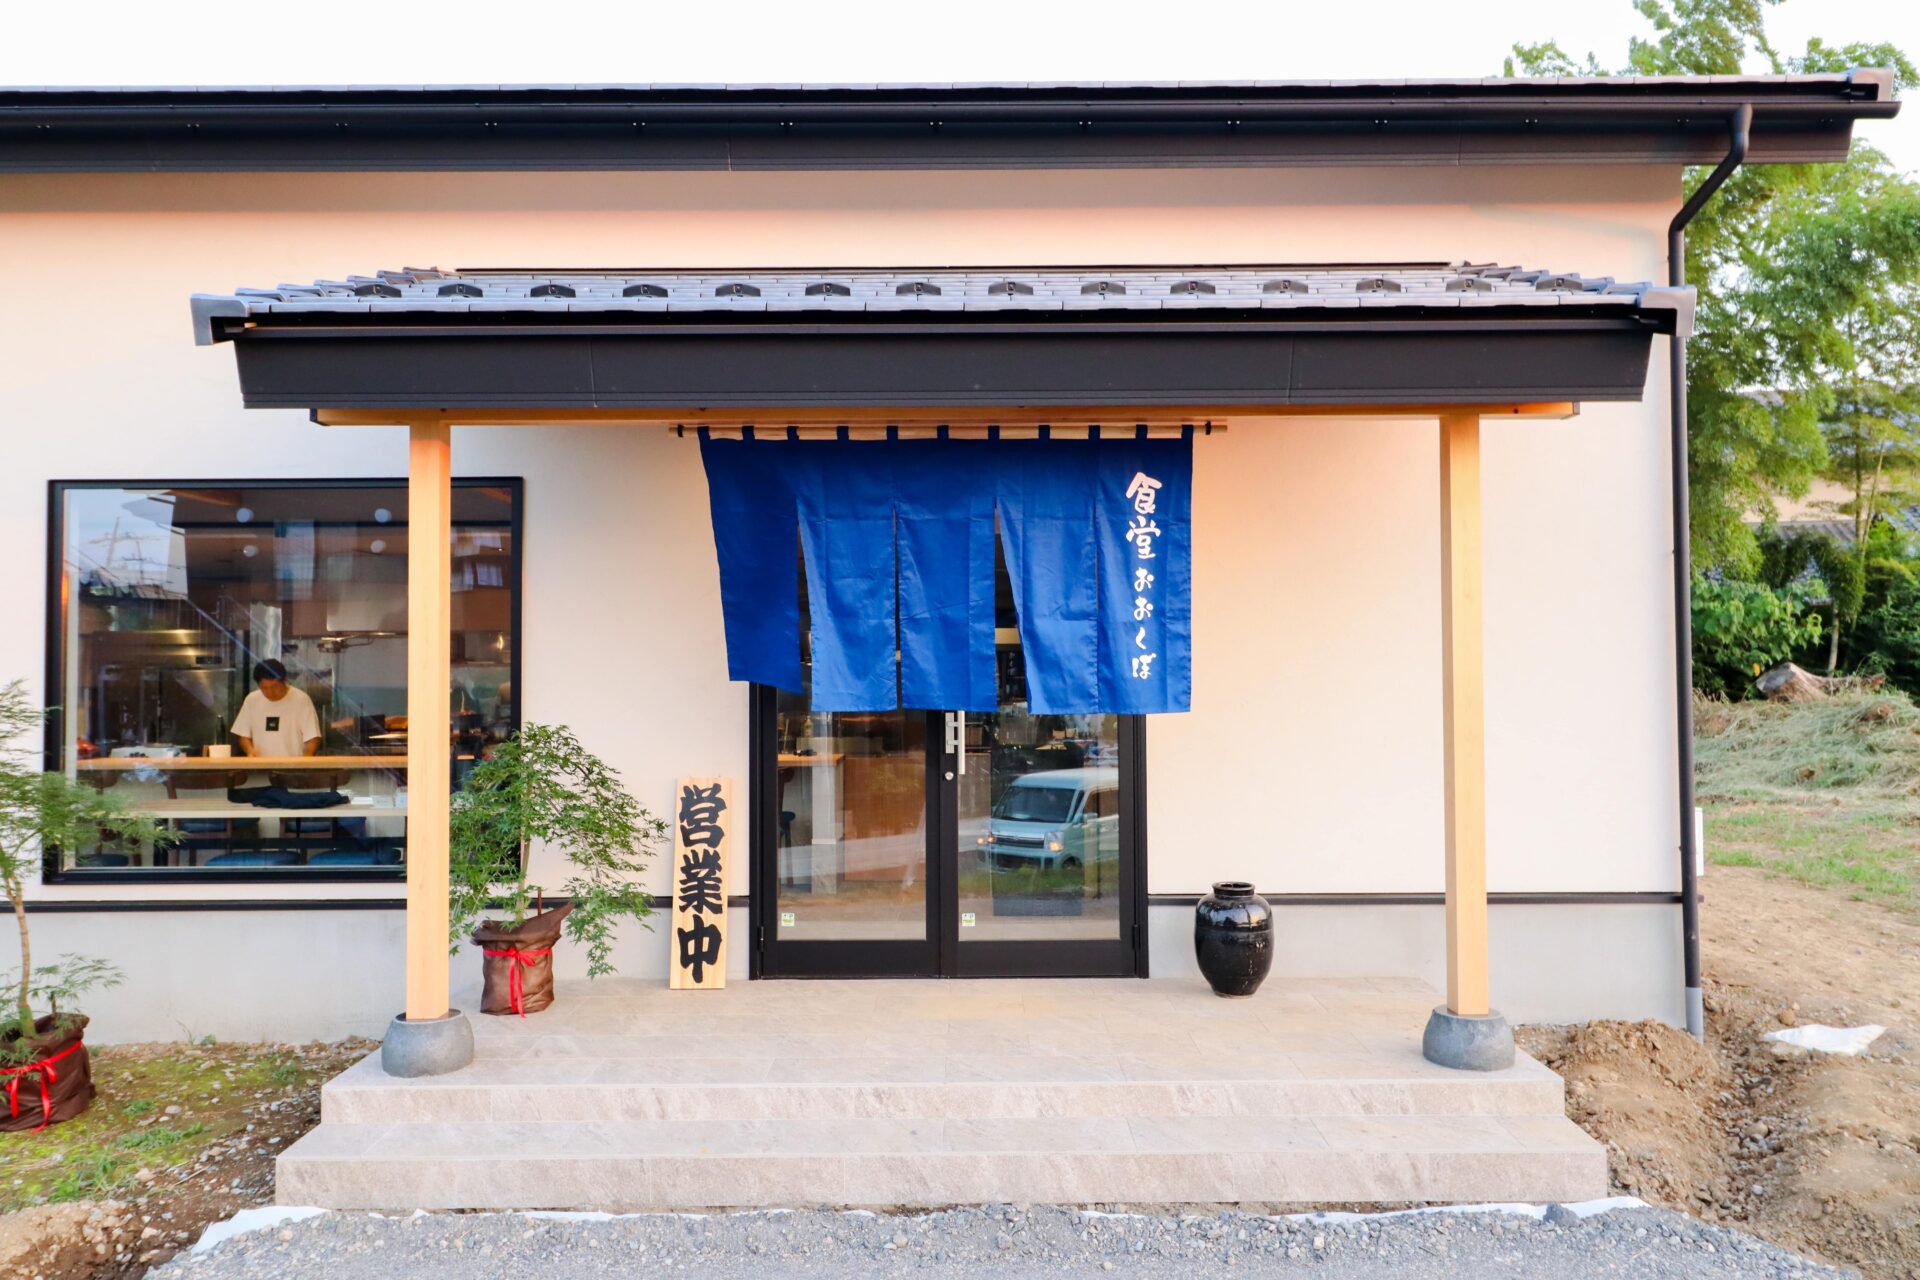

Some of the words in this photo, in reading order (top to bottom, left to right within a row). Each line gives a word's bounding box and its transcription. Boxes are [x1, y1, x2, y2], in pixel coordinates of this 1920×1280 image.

[1125, 471, 1163, 680] 食堂おおくぼ
[677, 782, 727, 984] 営業中
